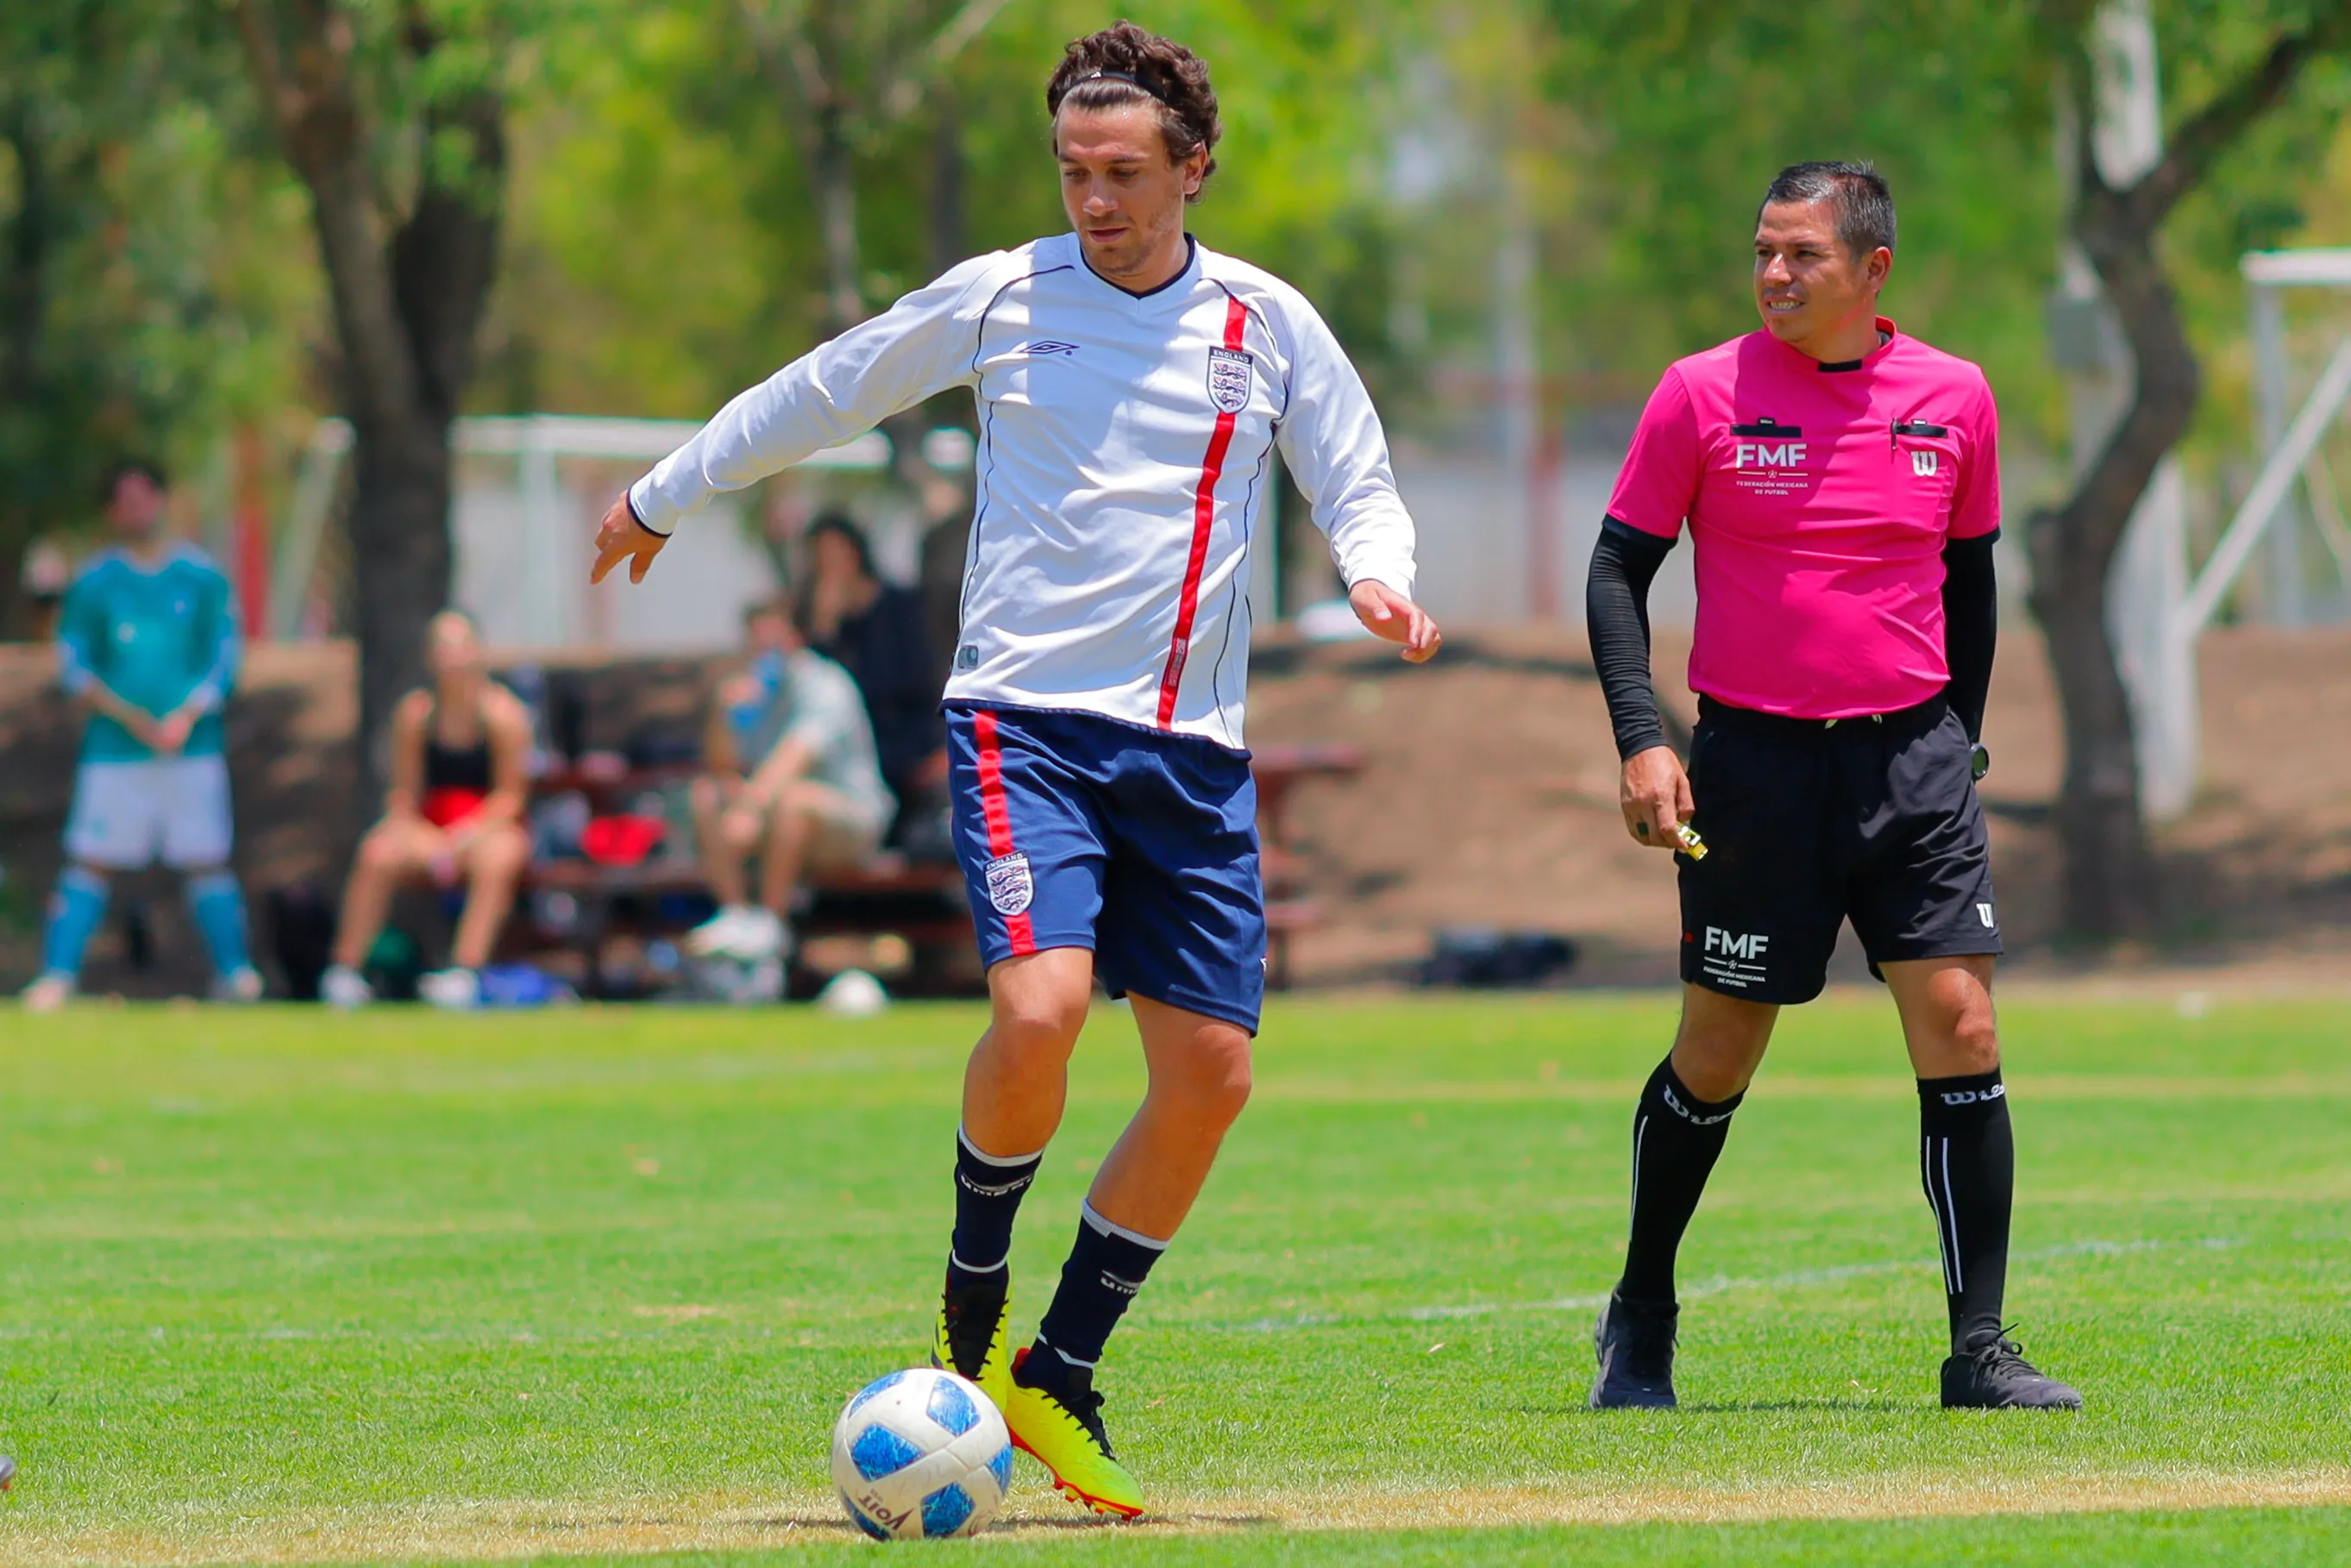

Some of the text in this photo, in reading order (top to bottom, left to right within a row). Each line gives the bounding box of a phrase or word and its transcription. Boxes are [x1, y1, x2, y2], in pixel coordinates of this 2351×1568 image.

[1213, 348, 1250, 364] ENGLAND
[1735, 442, 1808, 468] FMF
[986, 852, 1023, 870] ENGLAND
[1704, 925, 1769, 960] FMF
[856, 1493, 914, 1532] VOIT
